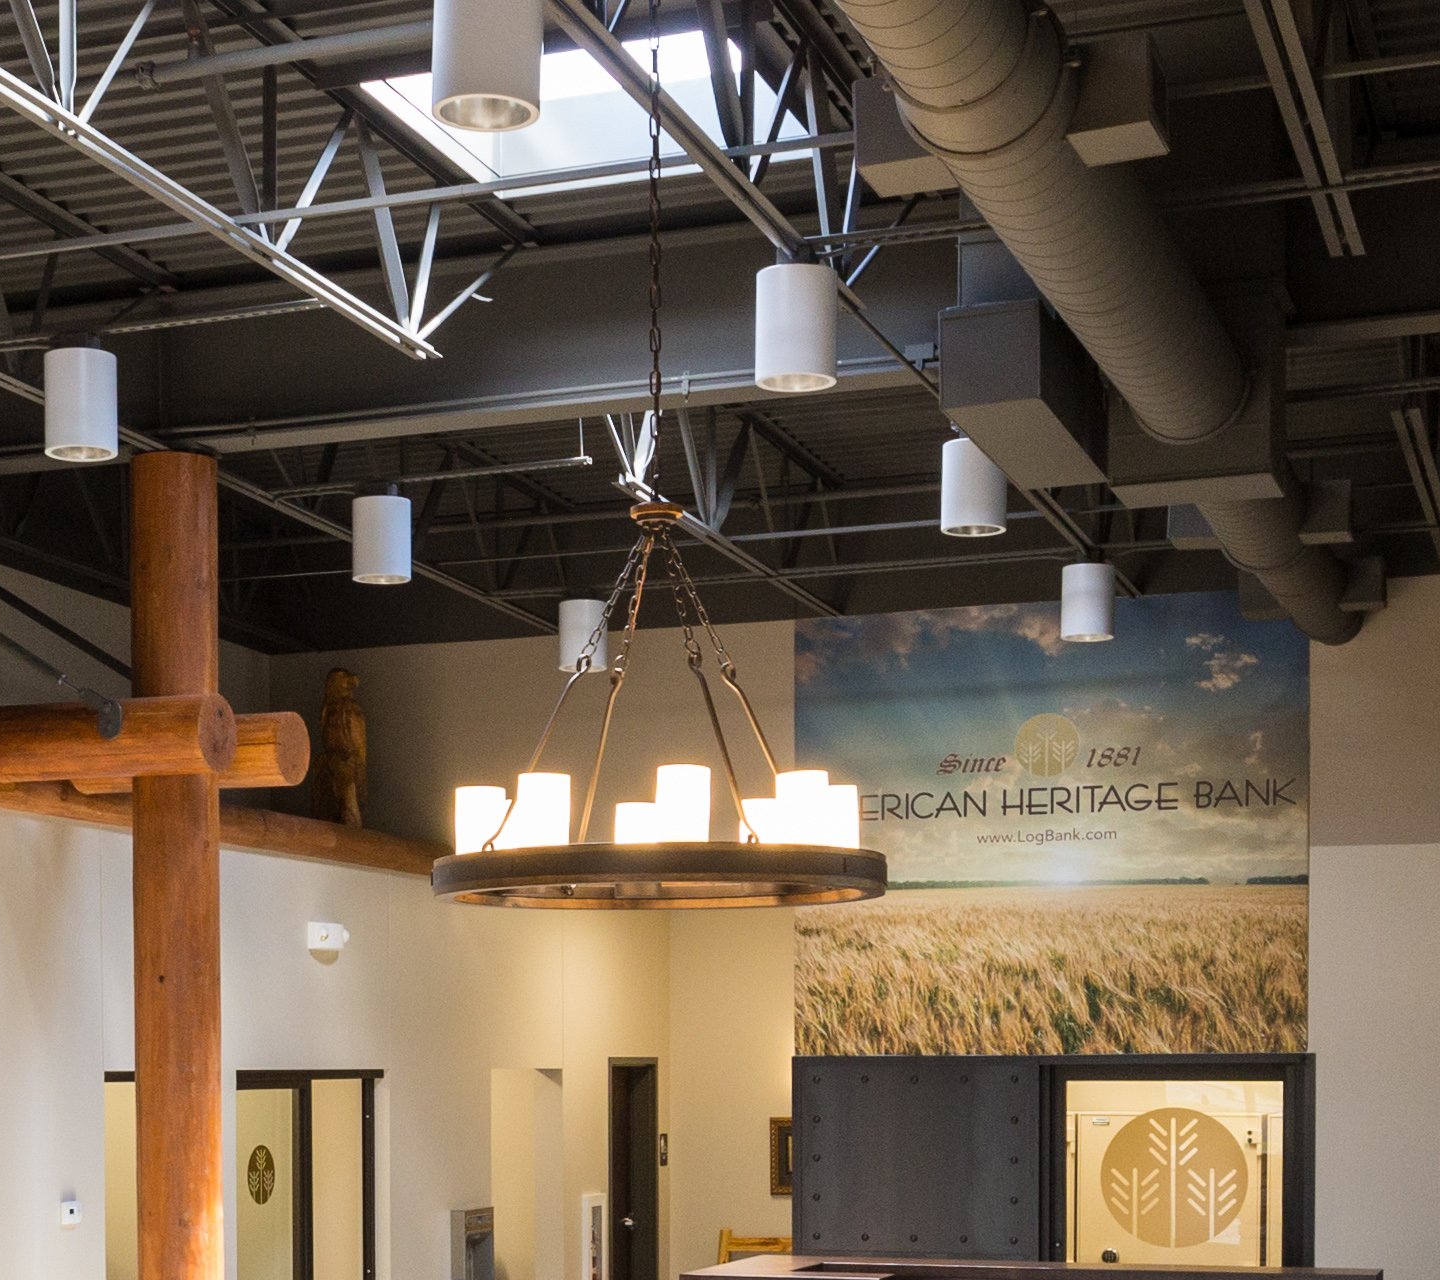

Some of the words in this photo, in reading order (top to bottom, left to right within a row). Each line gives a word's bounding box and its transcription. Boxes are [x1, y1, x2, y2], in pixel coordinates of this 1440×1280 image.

[936, 753, 1007, 775] Since
[1086, 747, 1141, 769] 1881
[860, 789, 987, 822] ERICAN
[1001, 782, 1179, 816] HERITAGE
[1193, 777, 1297, 808] BANK
[976, 828, 1118, 845] www.LogBank.com
